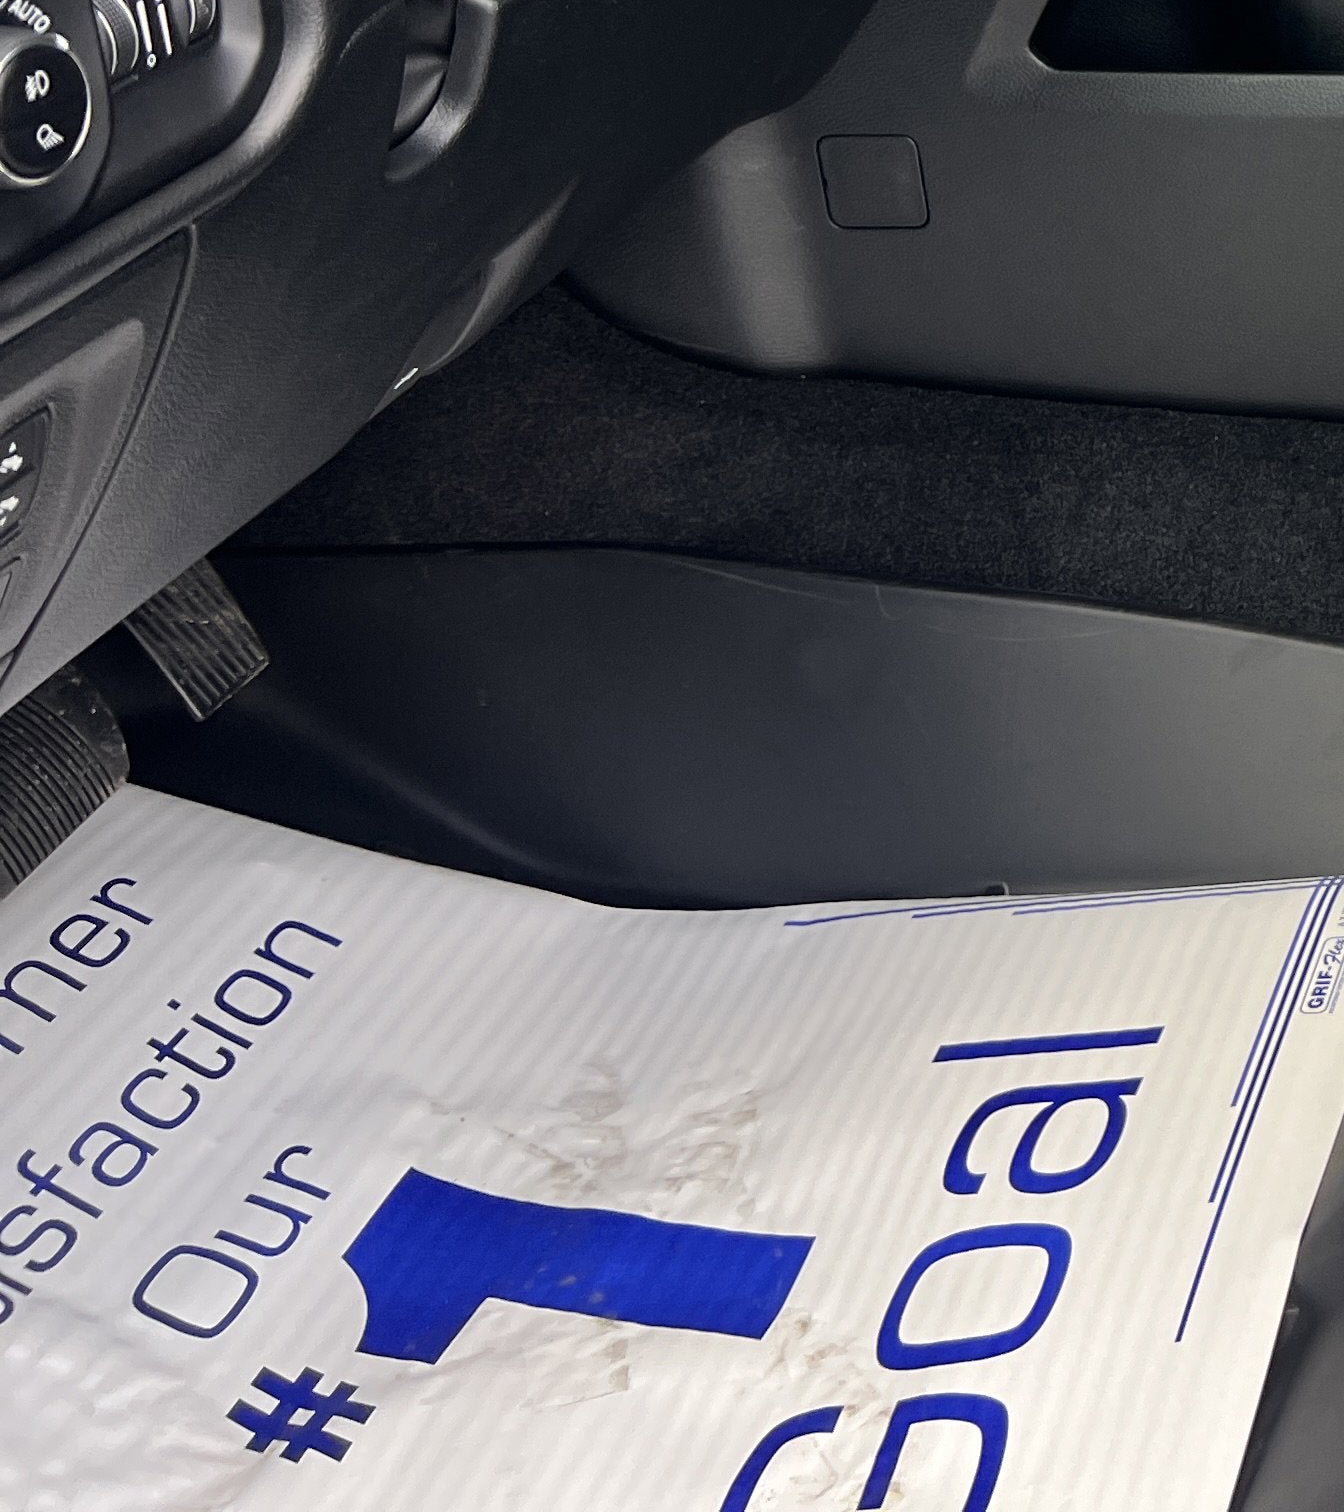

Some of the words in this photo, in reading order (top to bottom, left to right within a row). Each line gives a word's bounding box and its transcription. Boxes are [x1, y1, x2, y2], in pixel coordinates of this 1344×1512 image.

[0, 920, 342, 1324] sfaction
[132, 1145, 331, 1339] Our
[719, 1025, 1165, 1512] Goal
